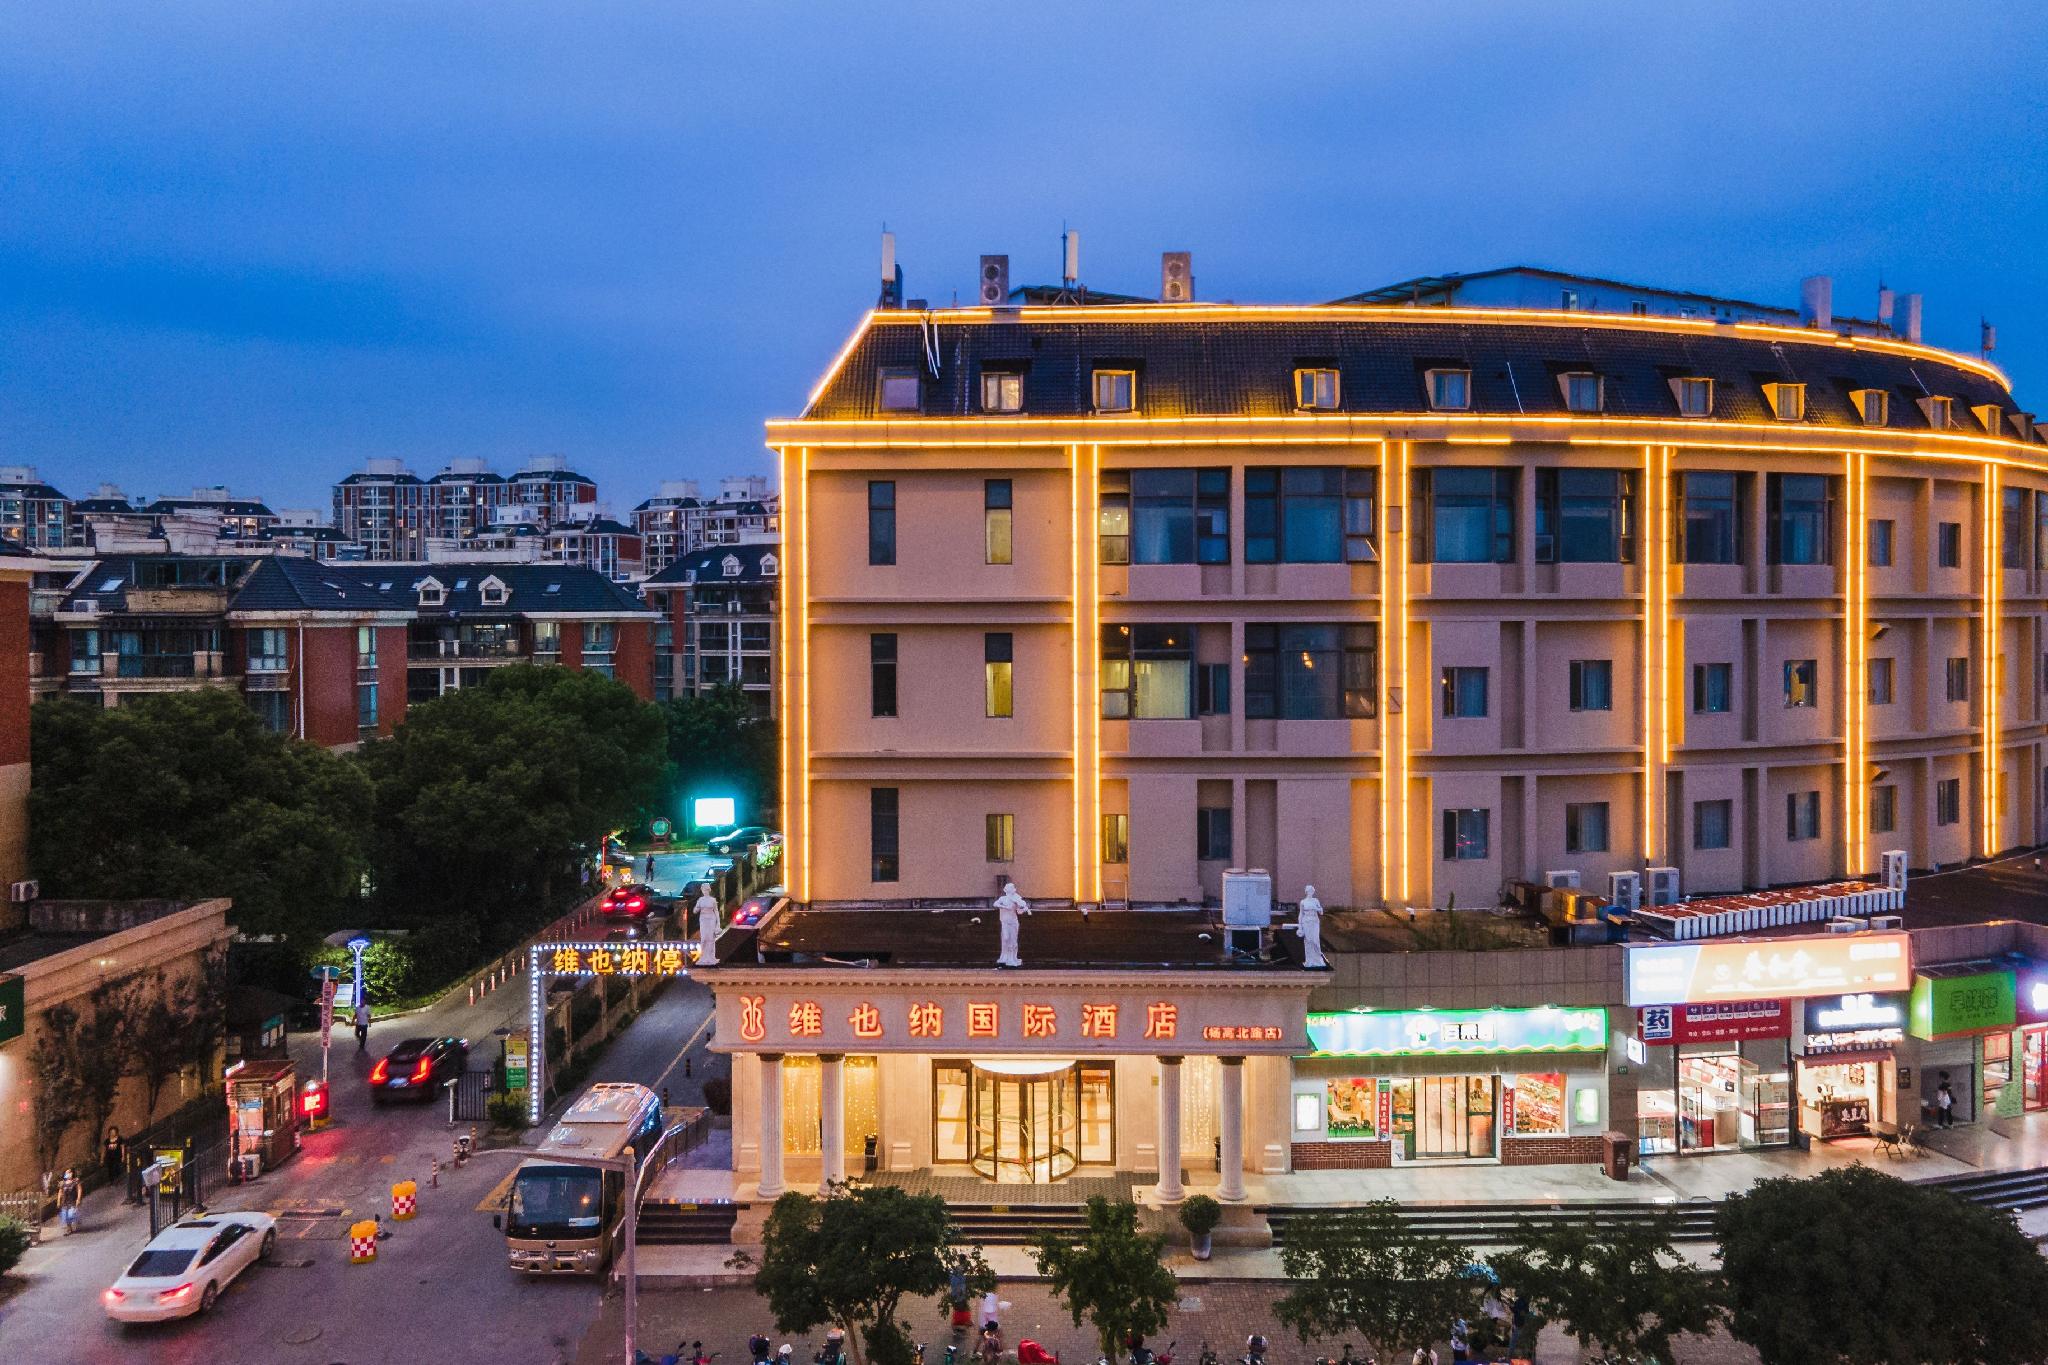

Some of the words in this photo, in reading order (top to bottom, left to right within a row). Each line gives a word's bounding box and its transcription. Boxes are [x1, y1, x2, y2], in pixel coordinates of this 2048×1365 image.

[553, 947, 701, 975] 维也纳停
[789, 1001, 1178, 1039] 维也纳国际酒店
[1647, 1009, 1669, 1030] 药
